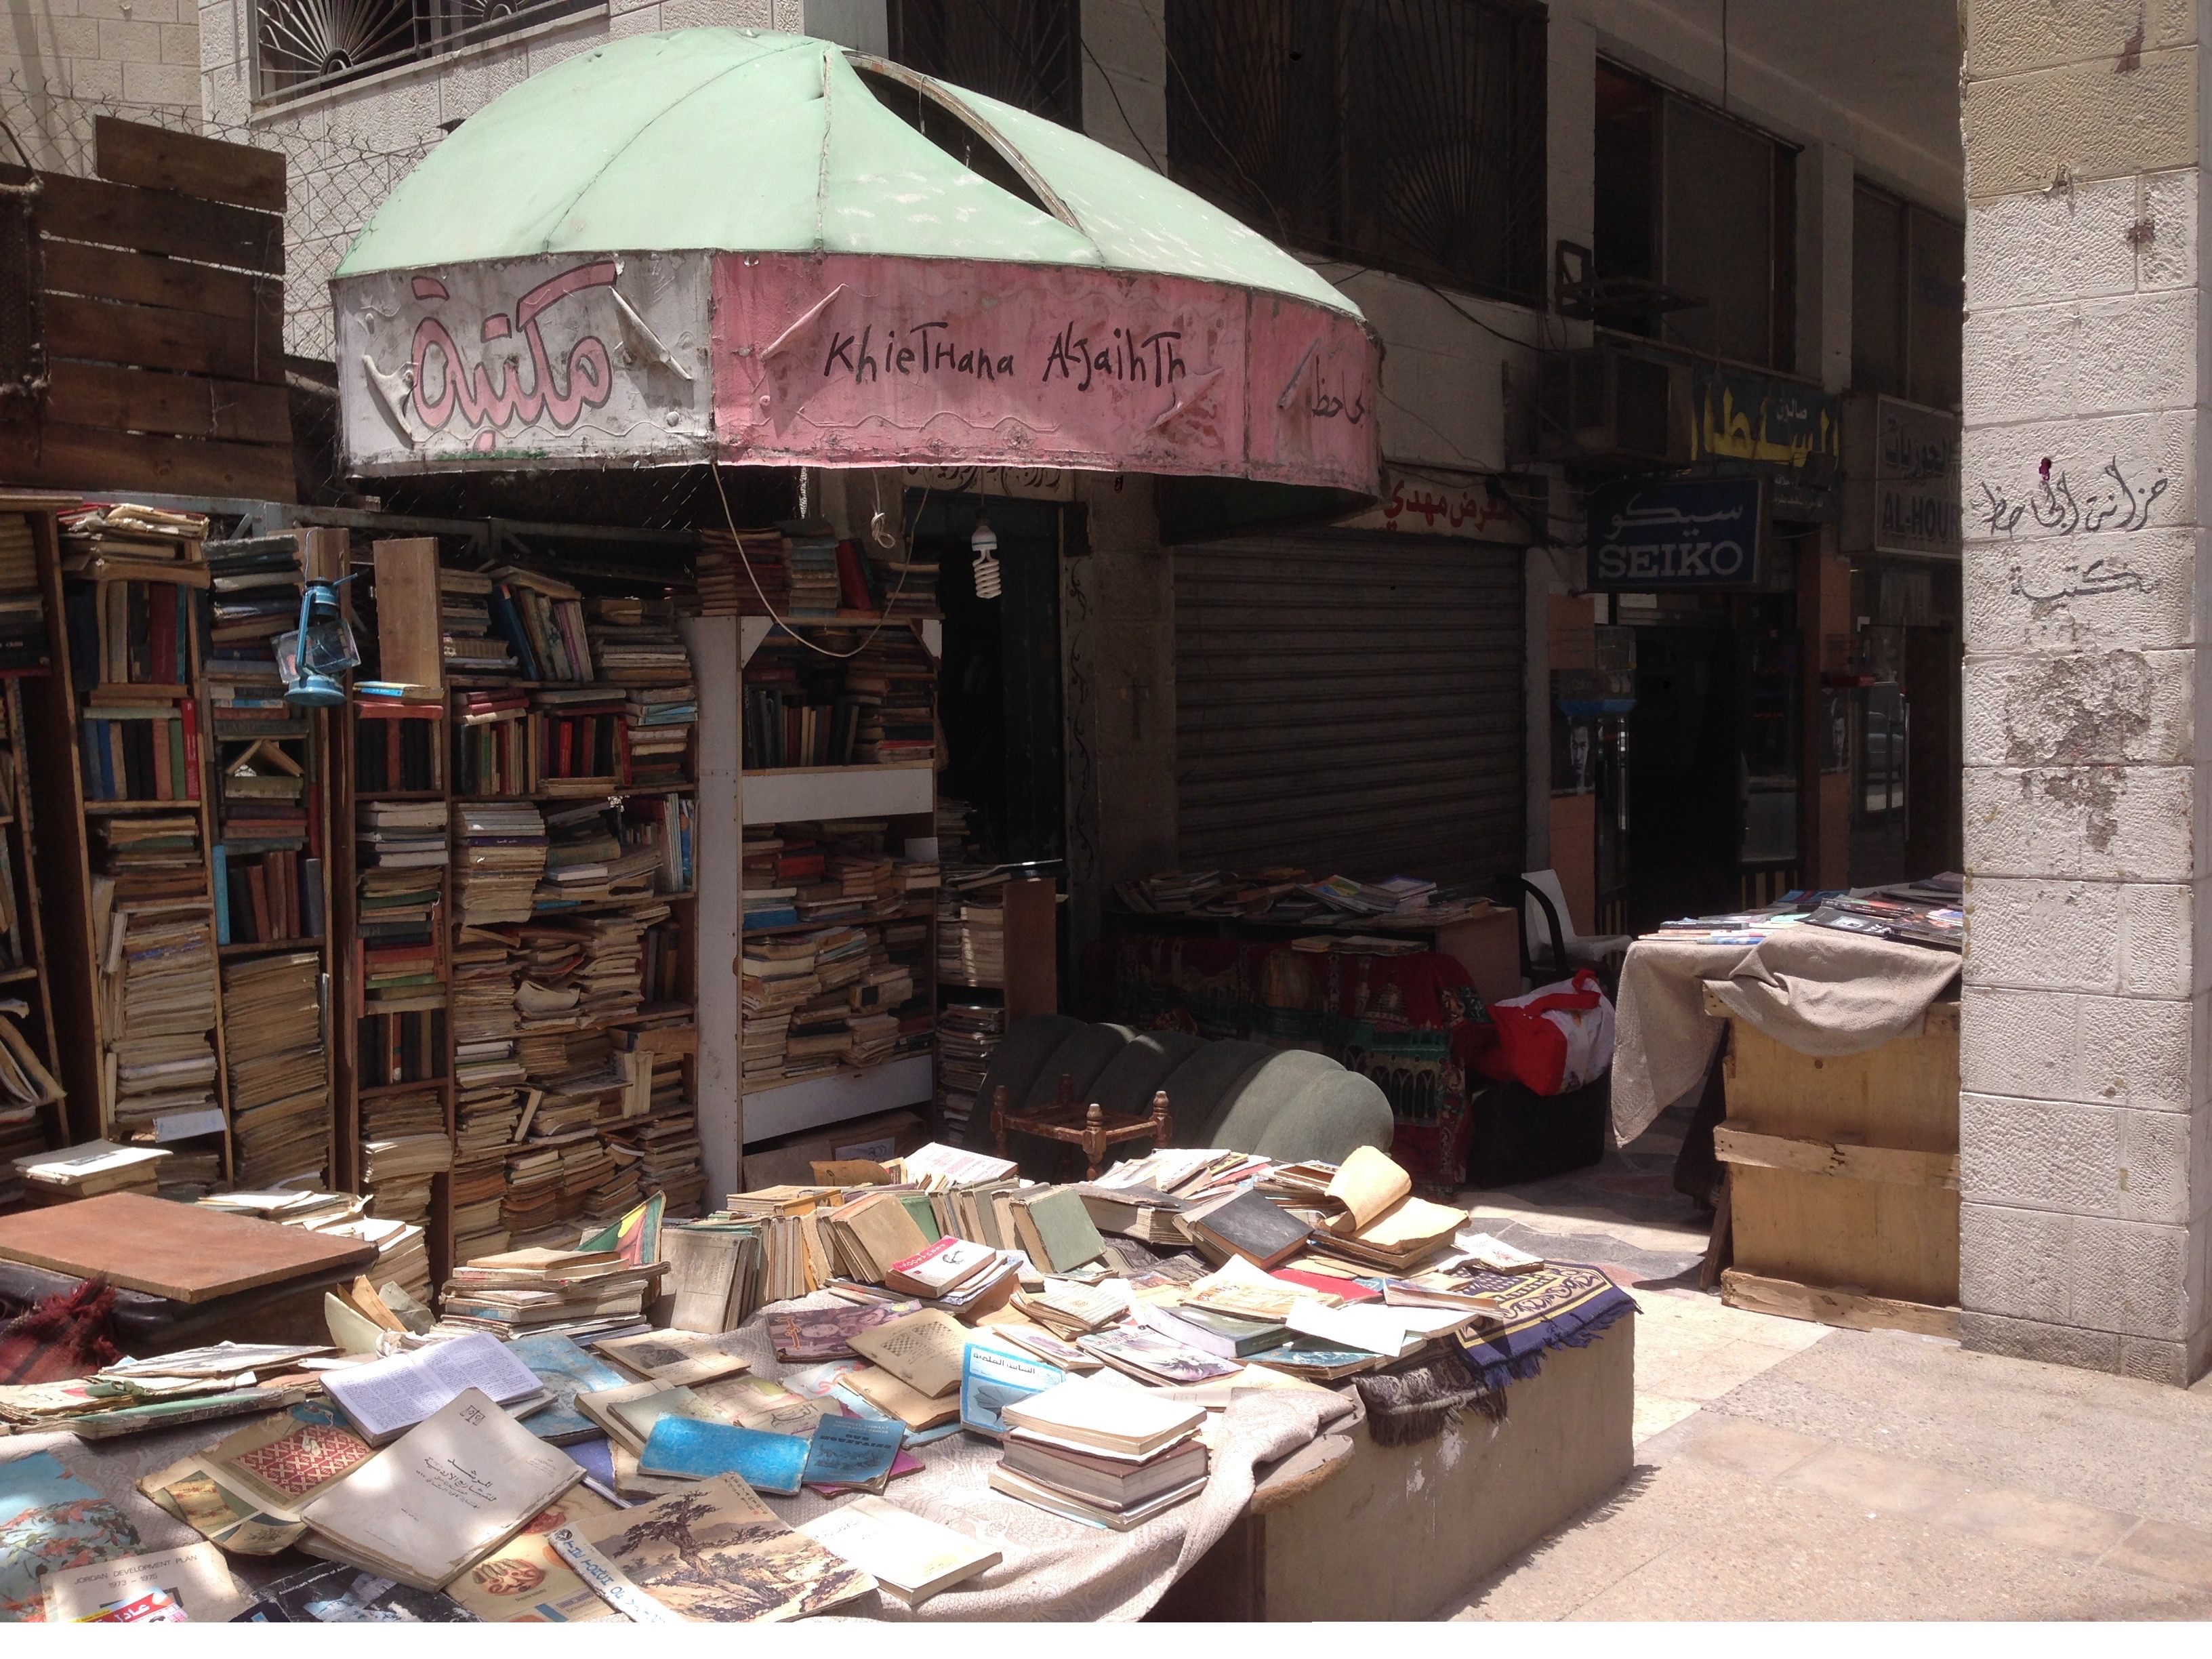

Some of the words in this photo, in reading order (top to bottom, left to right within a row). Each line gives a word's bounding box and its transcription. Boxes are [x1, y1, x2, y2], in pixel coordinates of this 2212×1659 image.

[411, 260, 617, 453] مكتبة
[1384, 480, 1448, 531] مهدي
[1604, 491, 1742, 539] سيكو
[1983, 470, 2078, 538] الجاحظ
[2085, 455, 2169, 532] خزانة
[1598, 540, 1742, 579] SEIKO
[447, 1458, 493, 1488] المرشد
[74, 1572, 108, 1585] JORDAN
[113, 1560, 171, 1577] DEVELOPMENT
[175, 1554, 197, 1565] PLAN
[108, 1579, 127, 1589] 1973
